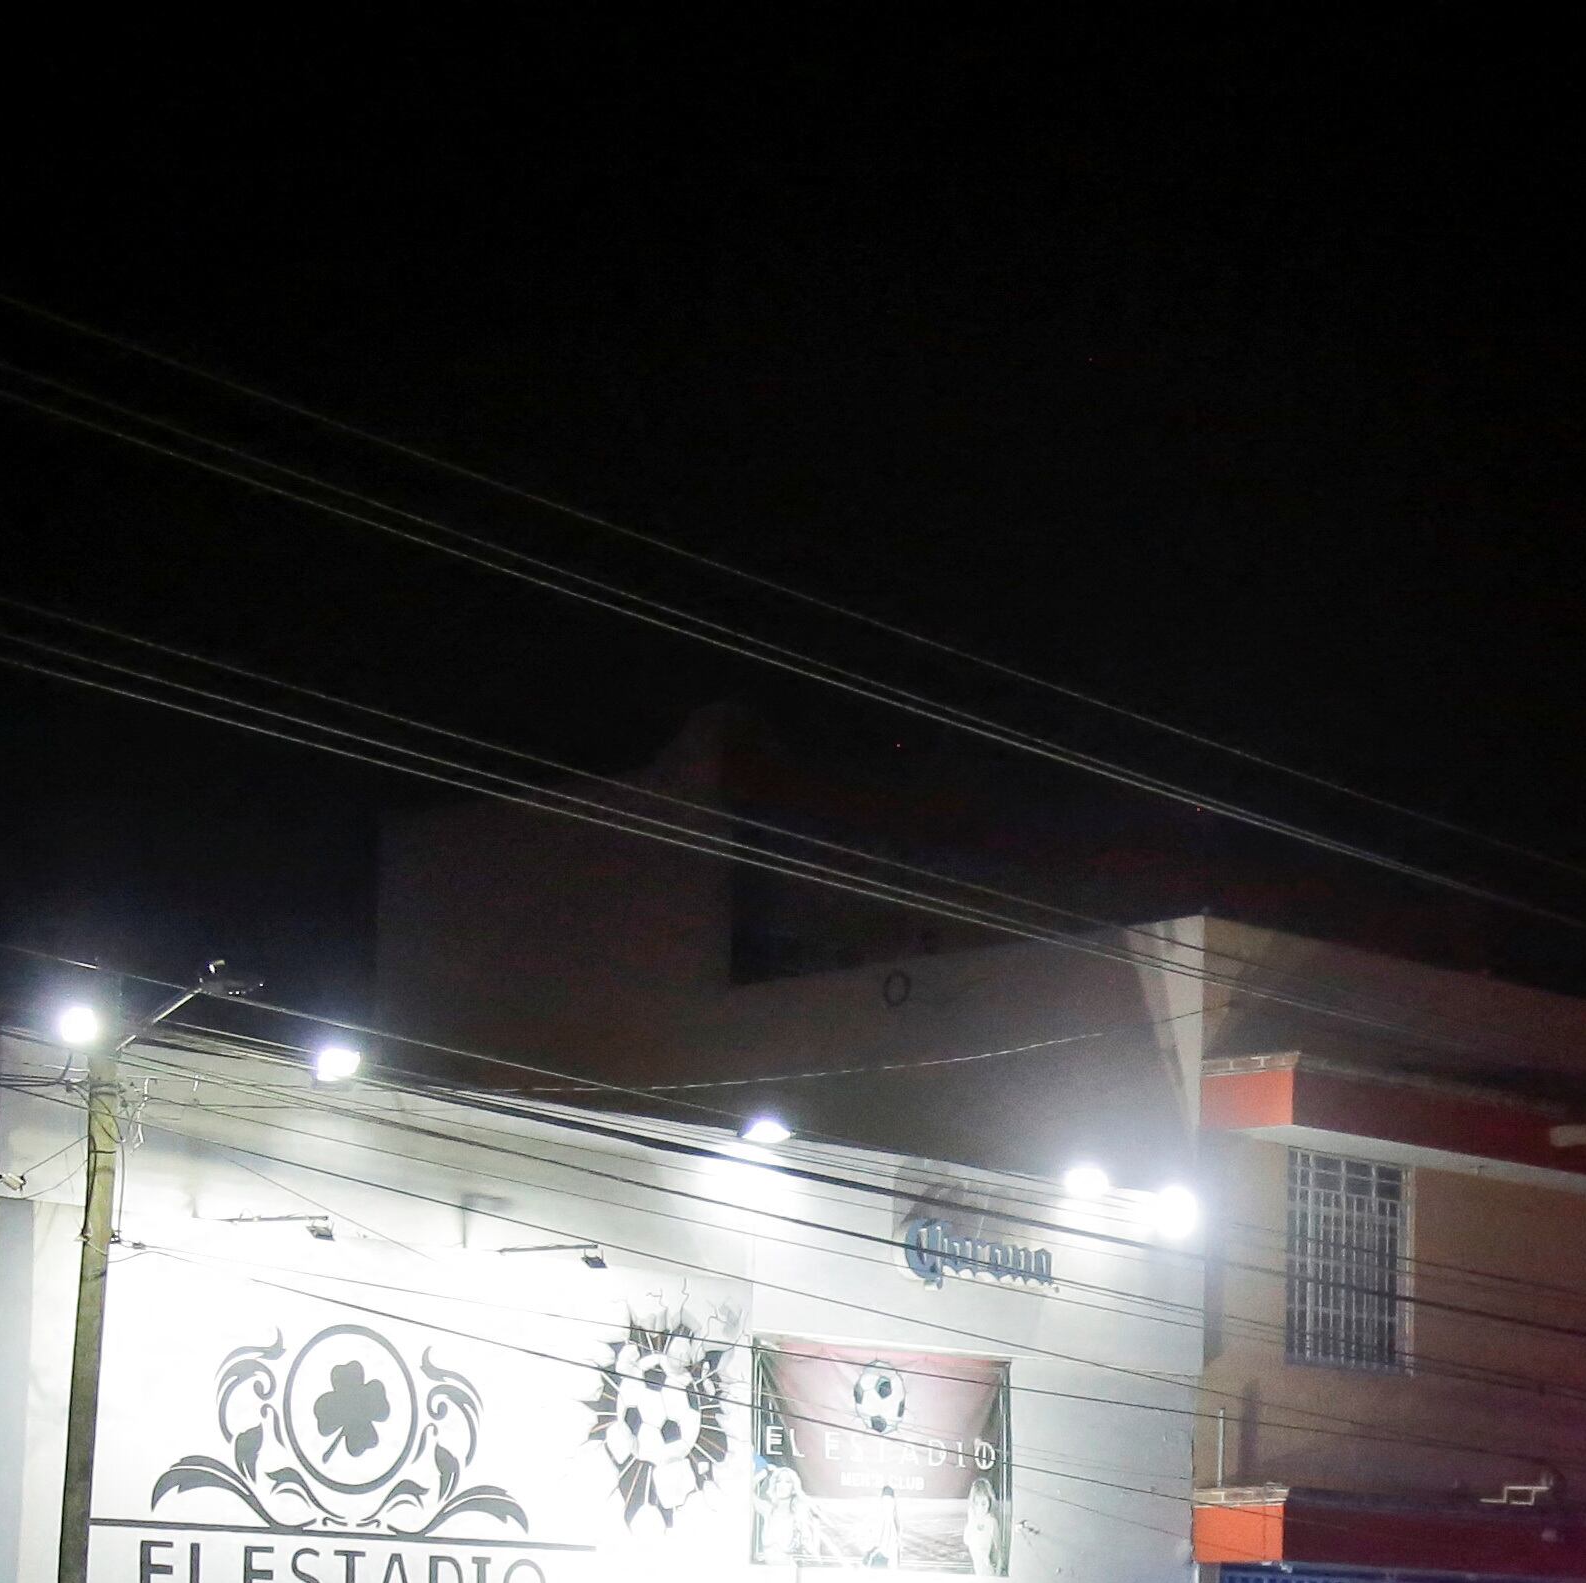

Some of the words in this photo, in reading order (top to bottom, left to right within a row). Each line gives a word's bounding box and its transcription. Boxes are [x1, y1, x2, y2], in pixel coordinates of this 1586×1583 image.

[765, 1425, 806, 1459] EL
[823, 1430, 996, 1471] ESTADIO
[891, 1474, 925, 1492] CLUB
